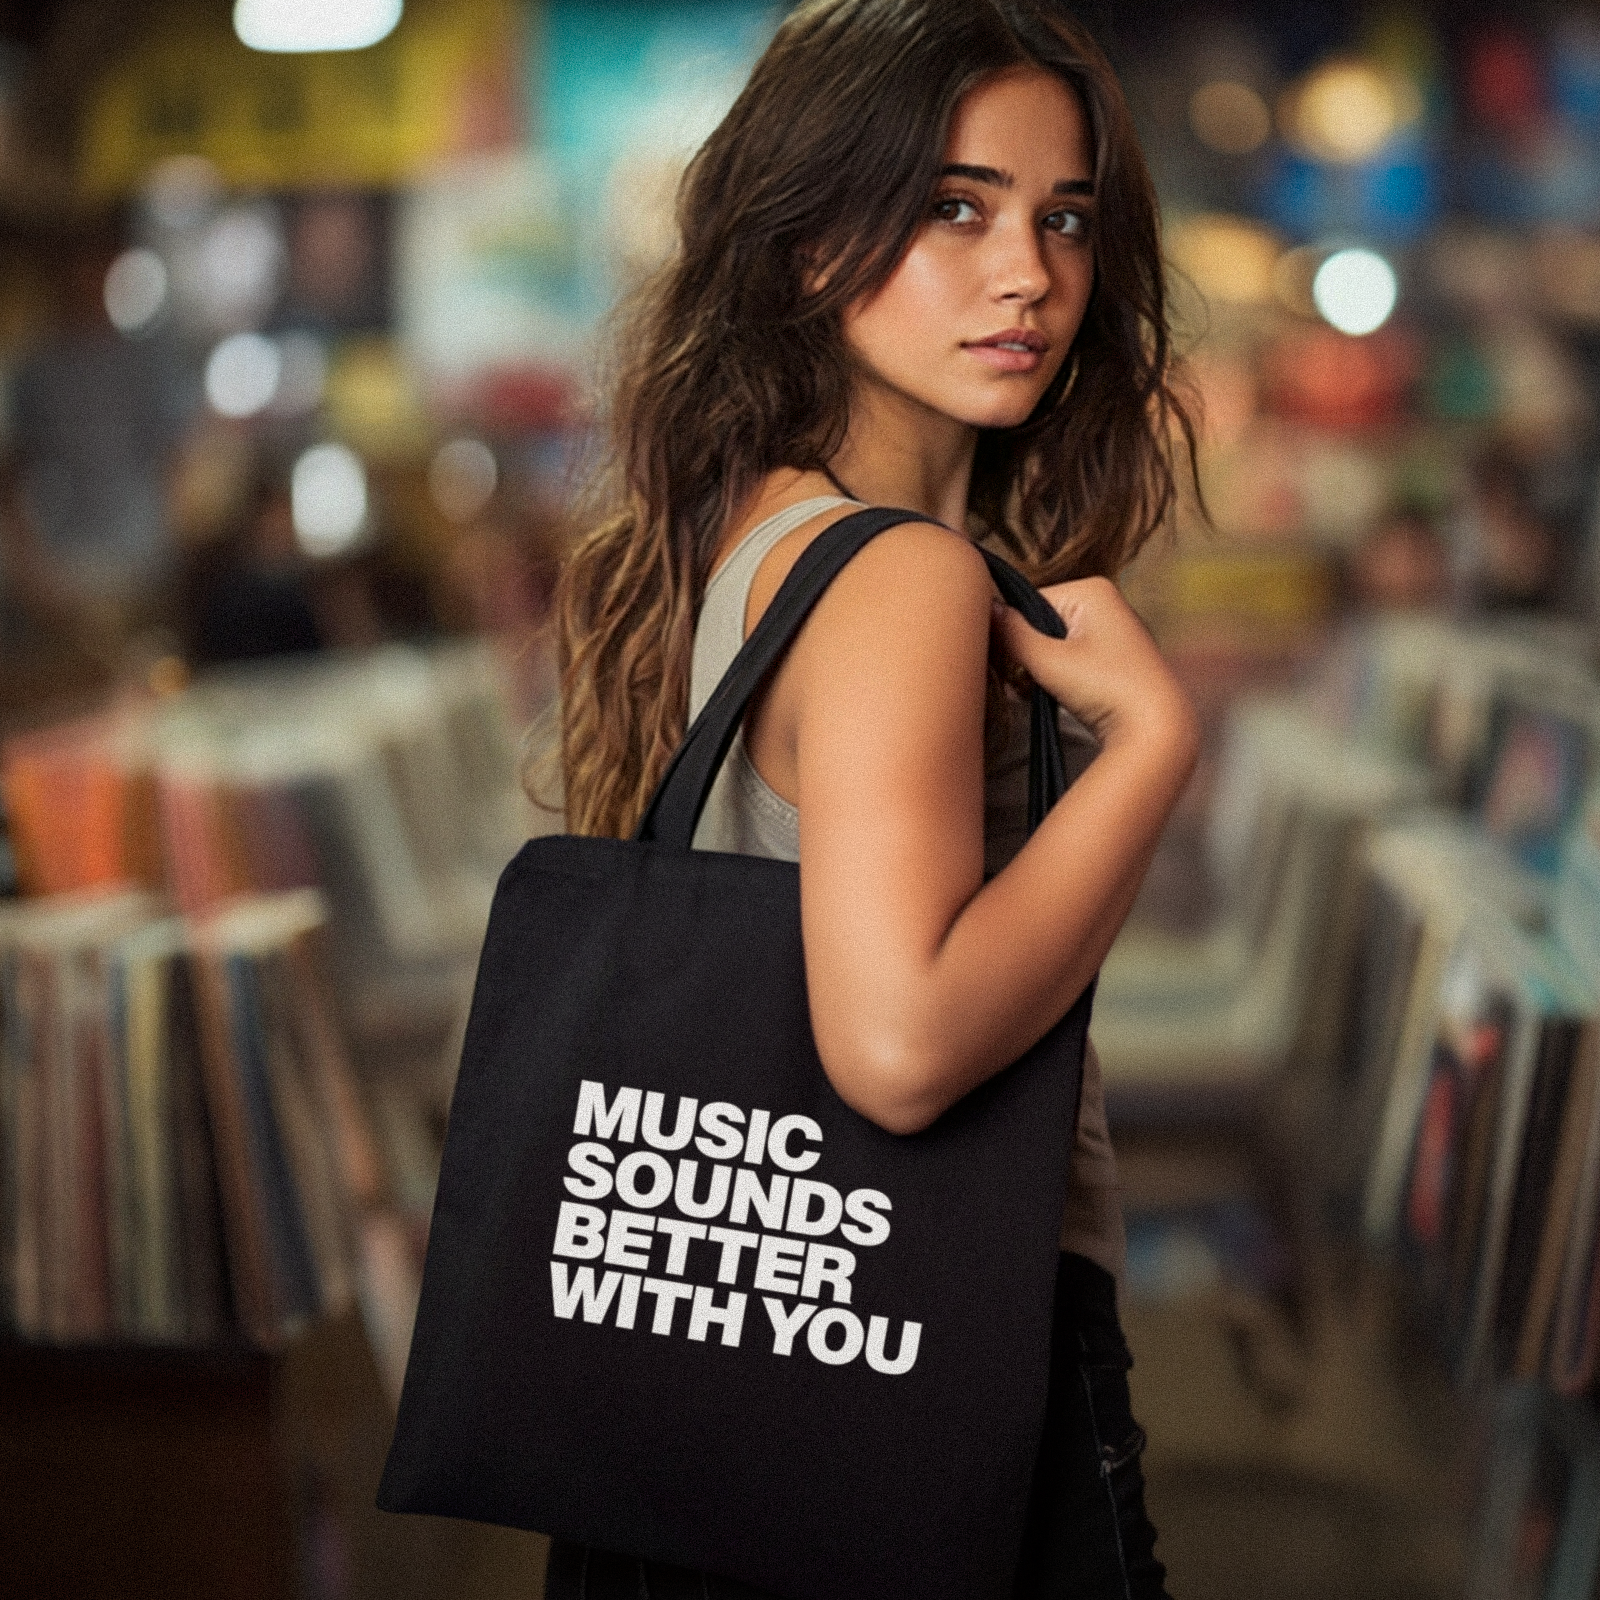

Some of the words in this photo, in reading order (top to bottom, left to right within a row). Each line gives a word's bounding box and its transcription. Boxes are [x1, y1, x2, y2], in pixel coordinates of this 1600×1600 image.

[573, 1080, 823, 1172] MUSIC
[563, 1142, 893, 1246] SOUNDS
[553, 1201, 857, 1304] BETTER
[550, 1262, 748, 1347] WITH
[762, 1297, 923, 1374] YOU
